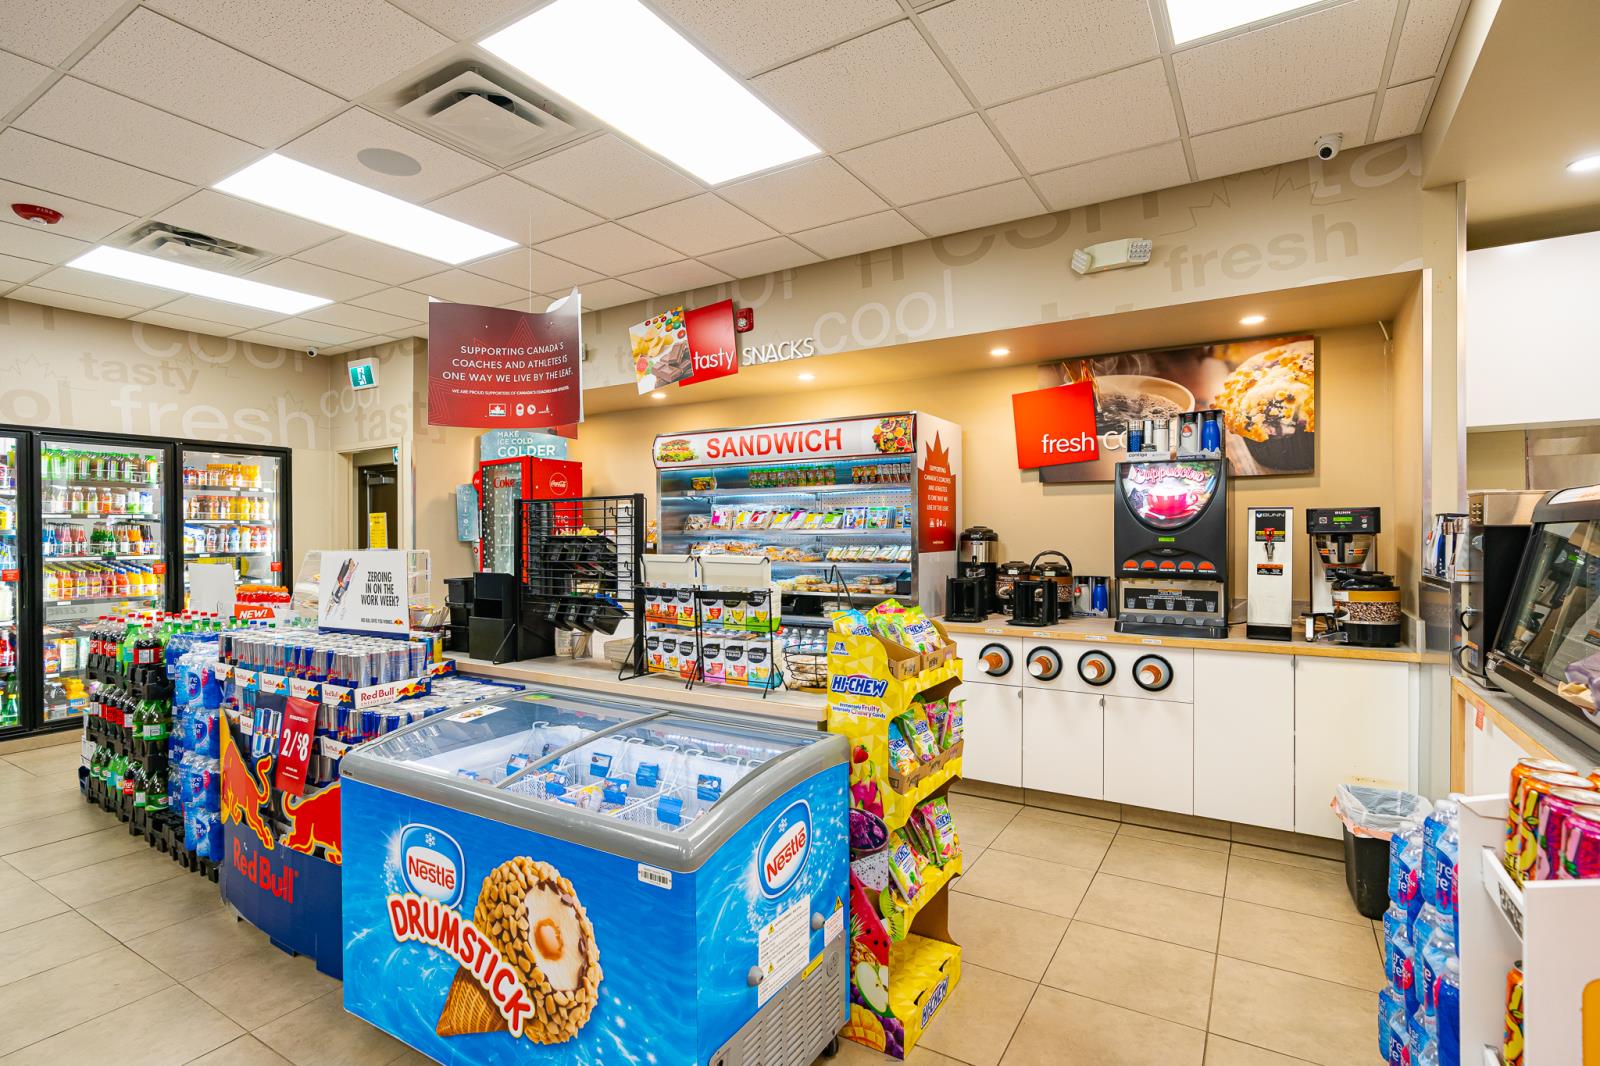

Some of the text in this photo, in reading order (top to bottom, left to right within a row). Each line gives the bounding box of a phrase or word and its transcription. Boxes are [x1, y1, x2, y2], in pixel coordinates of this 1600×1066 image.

[1164, 213, 1358, 292] fresh
[812, 268, 955, 354] cool
[460, 341, 564, 355] SUPPORTING CANADA'S
[693, 337, 816, 371] tasty SNACKS
[452, 354, 568, 369] COACHES AND ATHLETES IS
[79, 352, 199, 395] tasty
[442, 367, 574, 383] ONE WAY WE LIVE BY THE LEAF.
[110, 385, 318, 449] fresh
[498, 430, 520, 438] MAKE
[706, 427, 843, 459] SANDWICH
[1041, 431, 1094, 454] fresh
[497, 444, 556, 457] COLDER
[1133, 465, 1206, 485] Cappuccino
[367, 571, 392, 582] ZEROING
[365, 583, 394, 595] IN ON THE
[360, 594, 400, 607] WORK WEEK?
[239, 608, 269, 619] NEW!
[361, 687, 395, 702] Red Bull
[831, 674, 888, 698] HI-CHEW
[861, 704, 880, 712] Fruity
[281, 728, 310, 762] 2/$8
[233, 835, 294, 905] Red Bull
[390, 898, 531, 1032] DRUMSTICK
